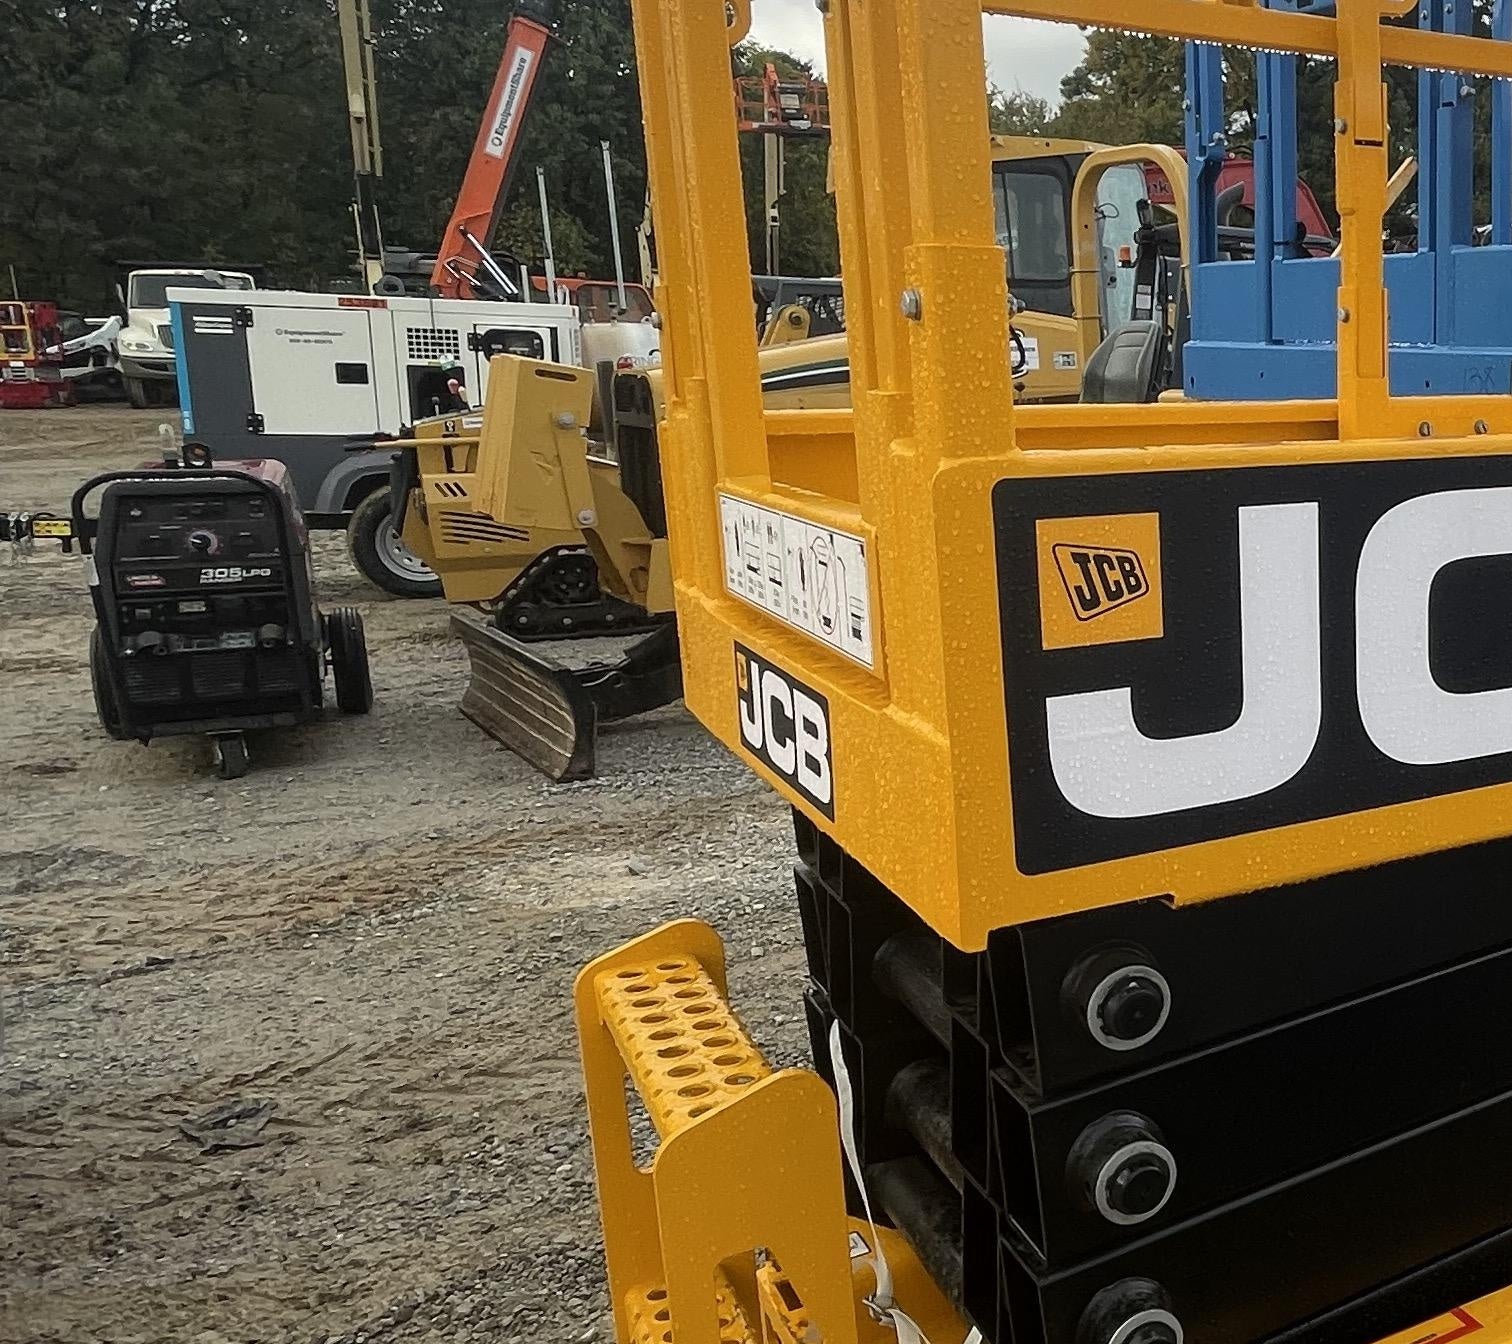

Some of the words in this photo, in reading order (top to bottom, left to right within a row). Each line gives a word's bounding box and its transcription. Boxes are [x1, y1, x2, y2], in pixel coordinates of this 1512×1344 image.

[494, 57, 528, 137] EquipmentShare
[1070, 552, 1142, 612] JCB
[740, 659, 831, 804] JCB
